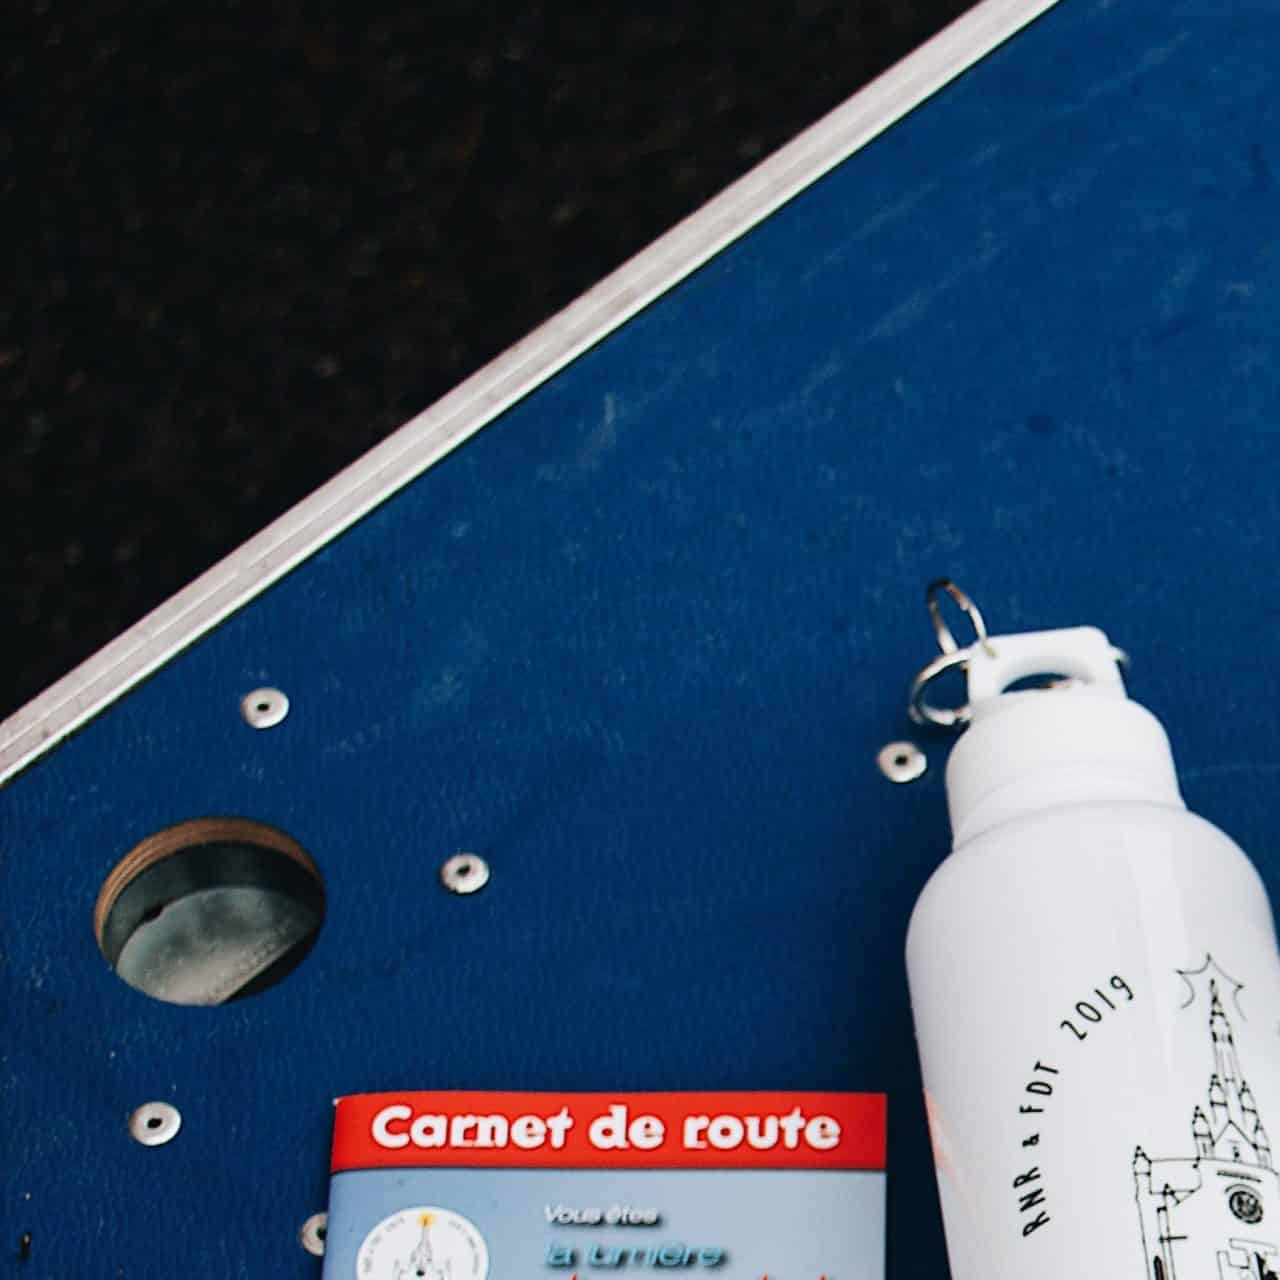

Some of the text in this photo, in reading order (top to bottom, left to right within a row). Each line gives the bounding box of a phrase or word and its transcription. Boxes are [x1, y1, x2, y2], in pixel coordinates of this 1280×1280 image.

[1060, 974, 1136, 1041] 2019
[1020, 1061, 1060, 1115] FDT
[371, 1105, 840, 1150] Carnet de route
[544, 1203, 602, 1225] Vous
[1013, 1166, 1051, 1237] RNR
